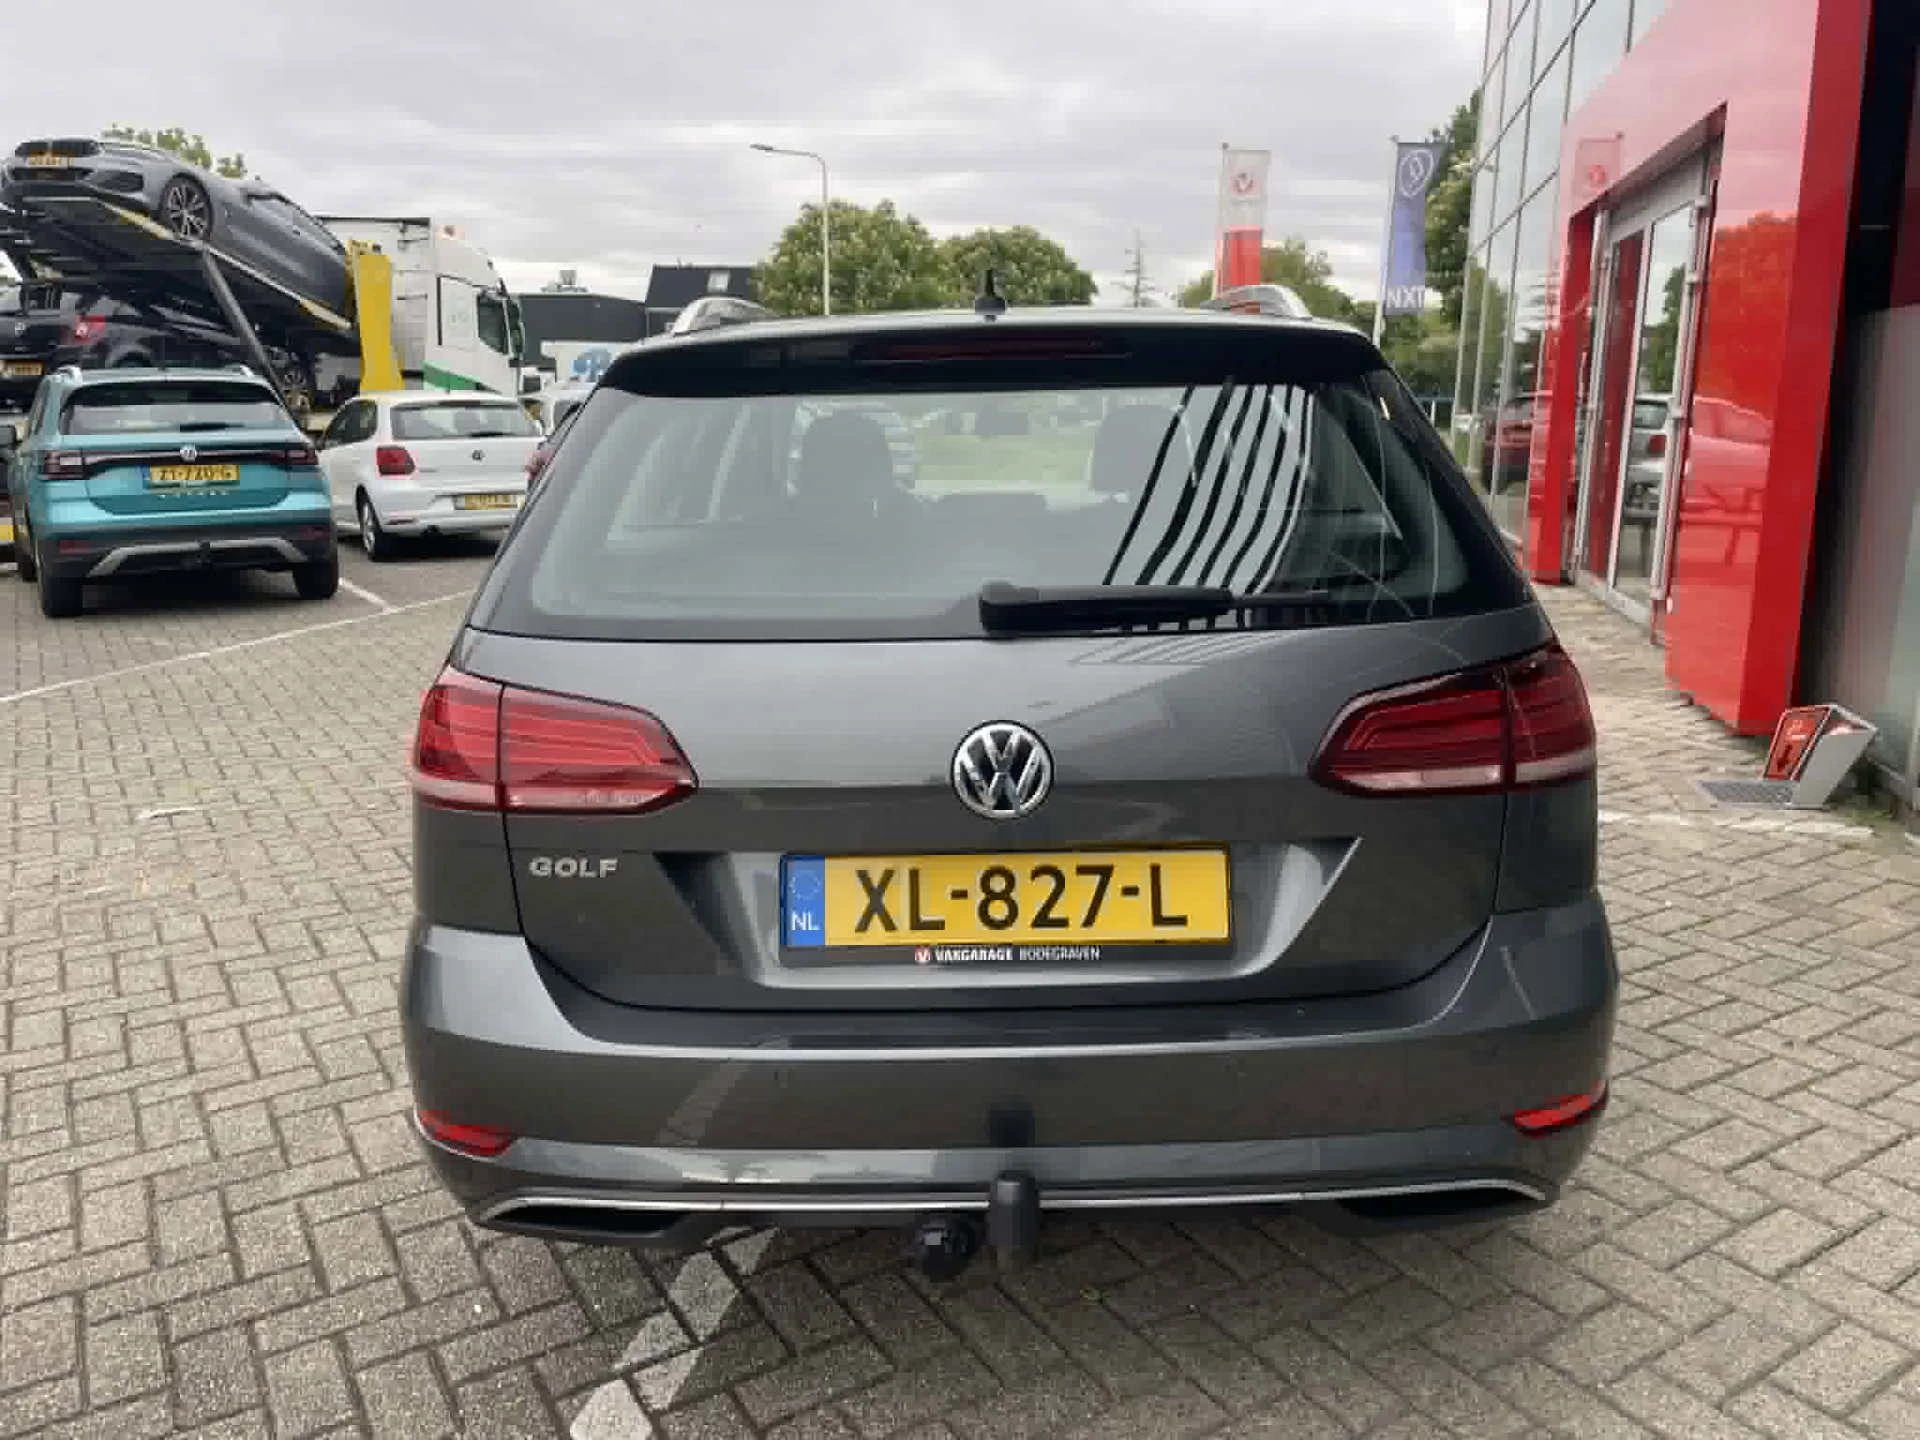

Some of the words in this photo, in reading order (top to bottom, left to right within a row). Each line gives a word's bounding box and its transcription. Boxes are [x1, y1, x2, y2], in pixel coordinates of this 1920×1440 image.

[529, 856, 619, 879] GOLF
[854, 863, 1189, 932] XL-827-L
[791, 911, 821, 932] NL
